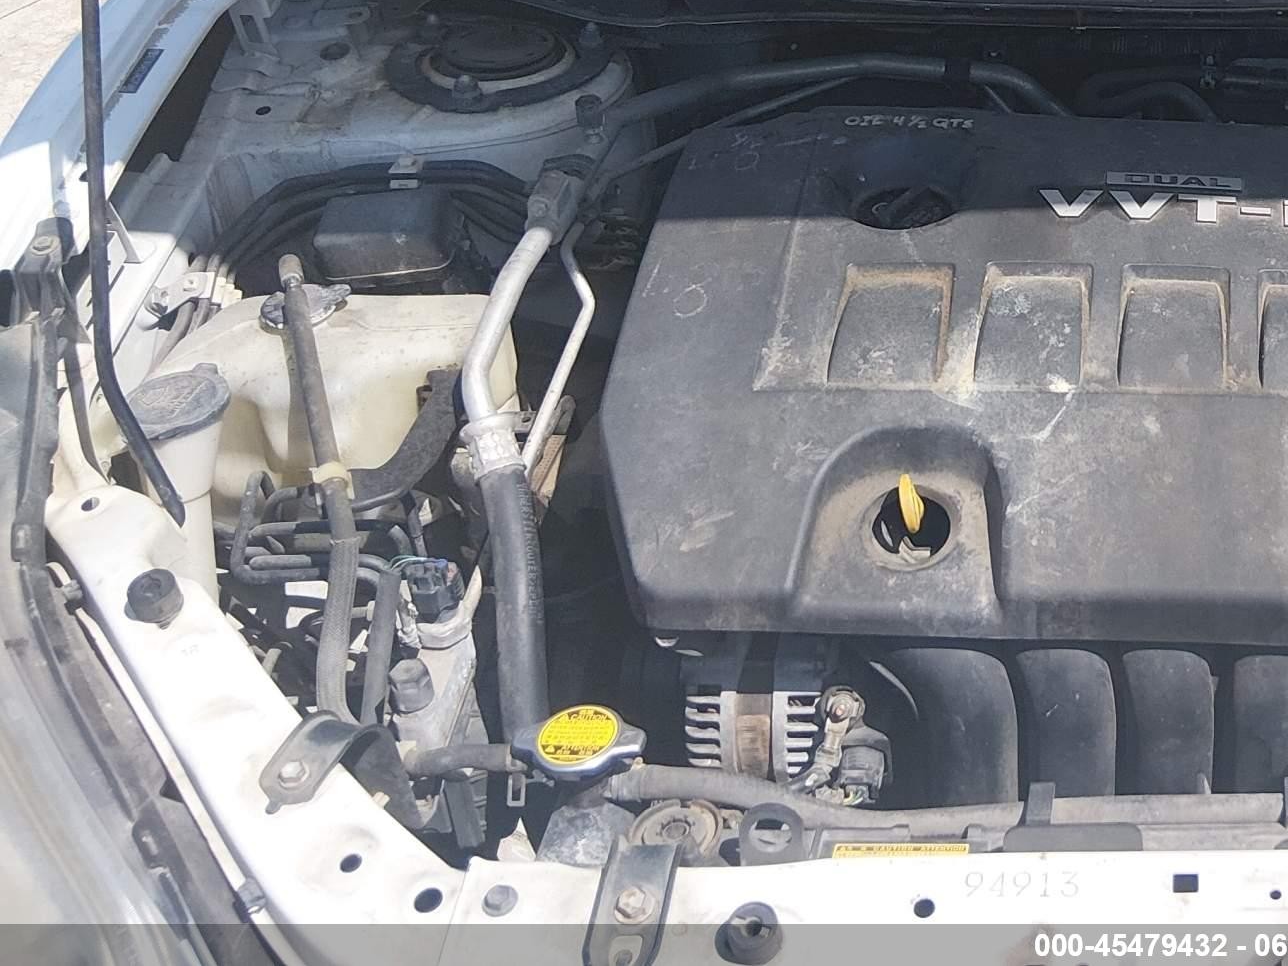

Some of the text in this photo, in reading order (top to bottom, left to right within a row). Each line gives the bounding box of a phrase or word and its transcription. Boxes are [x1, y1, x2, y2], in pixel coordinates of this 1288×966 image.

[893, 114, 906, 126] 4
[1124, 173, 1232, 188] DUAL
[570, 713, 607, 722] CAUTION
[964, 870, 1080, 899] 94913
